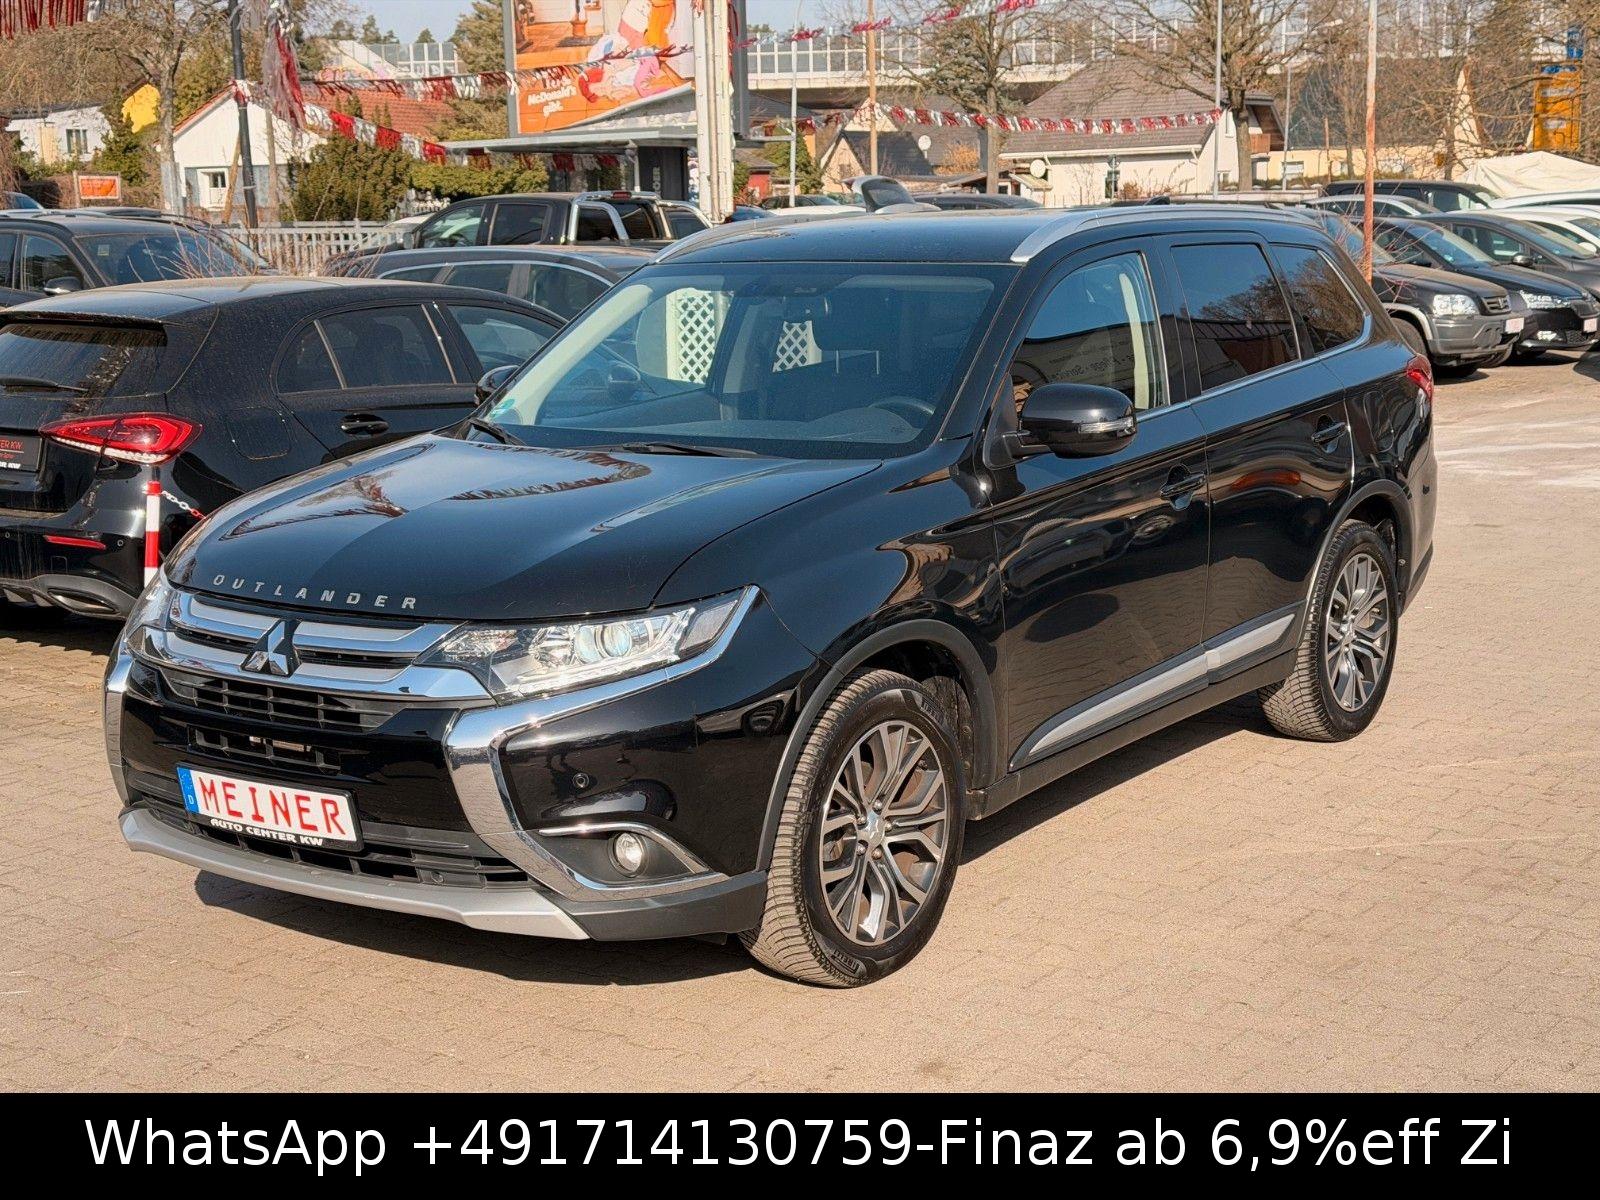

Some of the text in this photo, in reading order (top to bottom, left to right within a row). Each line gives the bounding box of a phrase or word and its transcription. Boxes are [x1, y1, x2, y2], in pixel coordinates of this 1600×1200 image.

[212, 574, 417, 610] OUTLANDER
[187, 794, 195, 805] D
[198, 776, 346, 835] MEINER
[210, 818, 323, 847] AUTO CENTER KW
